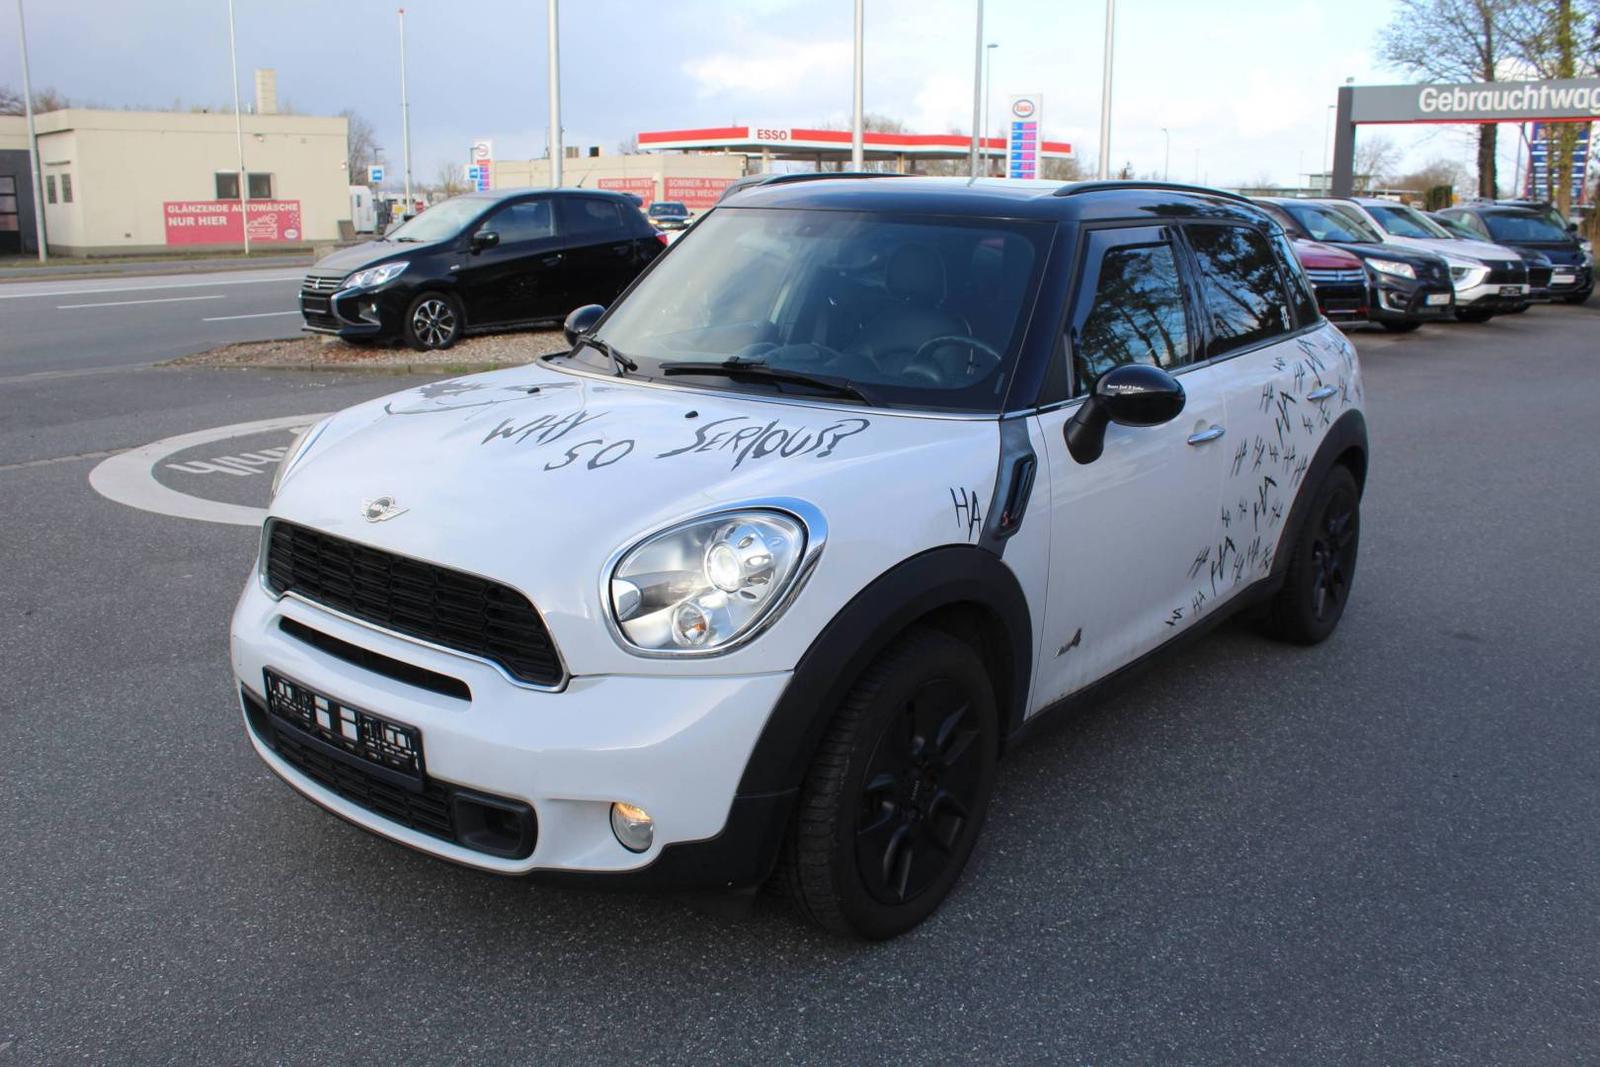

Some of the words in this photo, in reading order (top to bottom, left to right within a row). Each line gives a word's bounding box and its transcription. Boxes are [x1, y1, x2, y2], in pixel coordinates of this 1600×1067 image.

[1418, 84, 1600, 115] Gebrauchtwag
[756, 129, 788, 141] ESSO
[168, 216, 195, 227] NUR
[198, 215, 228, 226] HIER
[481, 409, 610, 447] WHY
[655, 416, 871, 472] SERIOUS?
[543, 438, 636, 472] SO
[950, 486, 982, 543] HA
